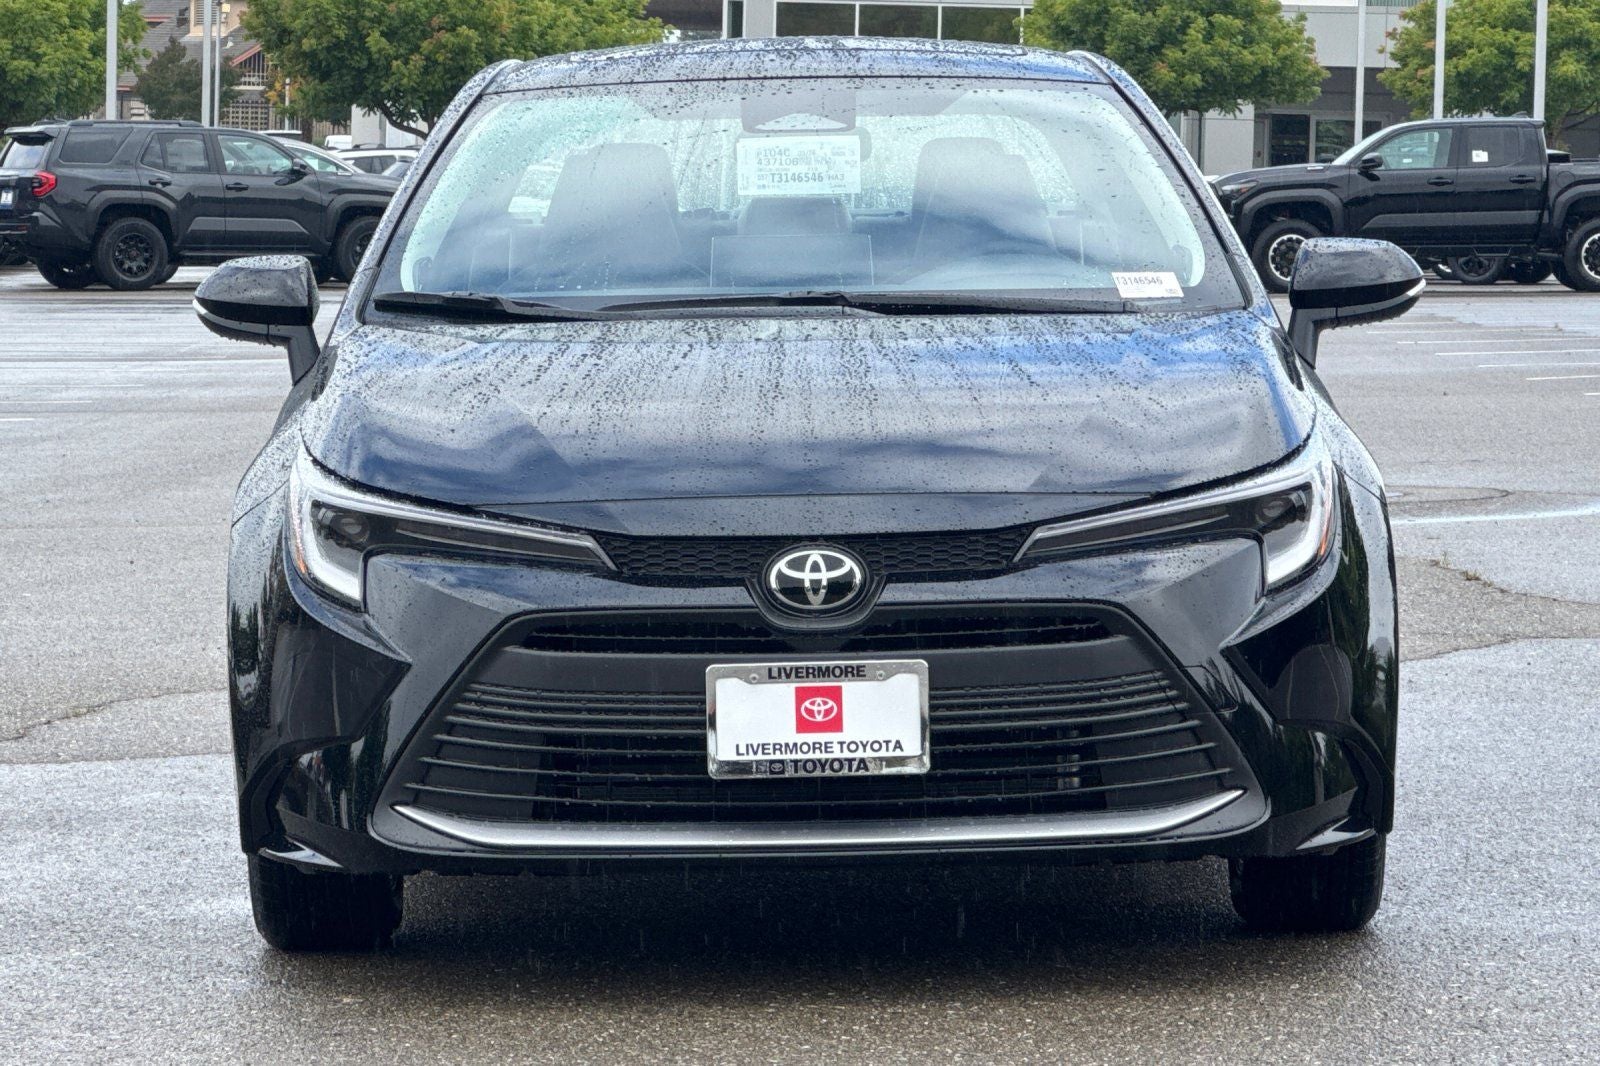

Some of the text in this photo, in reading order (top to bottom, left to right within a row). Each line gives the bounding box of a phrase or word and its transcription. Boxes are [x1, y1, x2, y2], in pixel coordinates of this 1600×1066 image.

[770, 173, 824, 183] T3146546
[767, 664, 867, 680] LIVERMORE
[735, 739, 904, 757] LIVERMORE TOYOTA
[790, 758, 870, 774] TOYOTA
